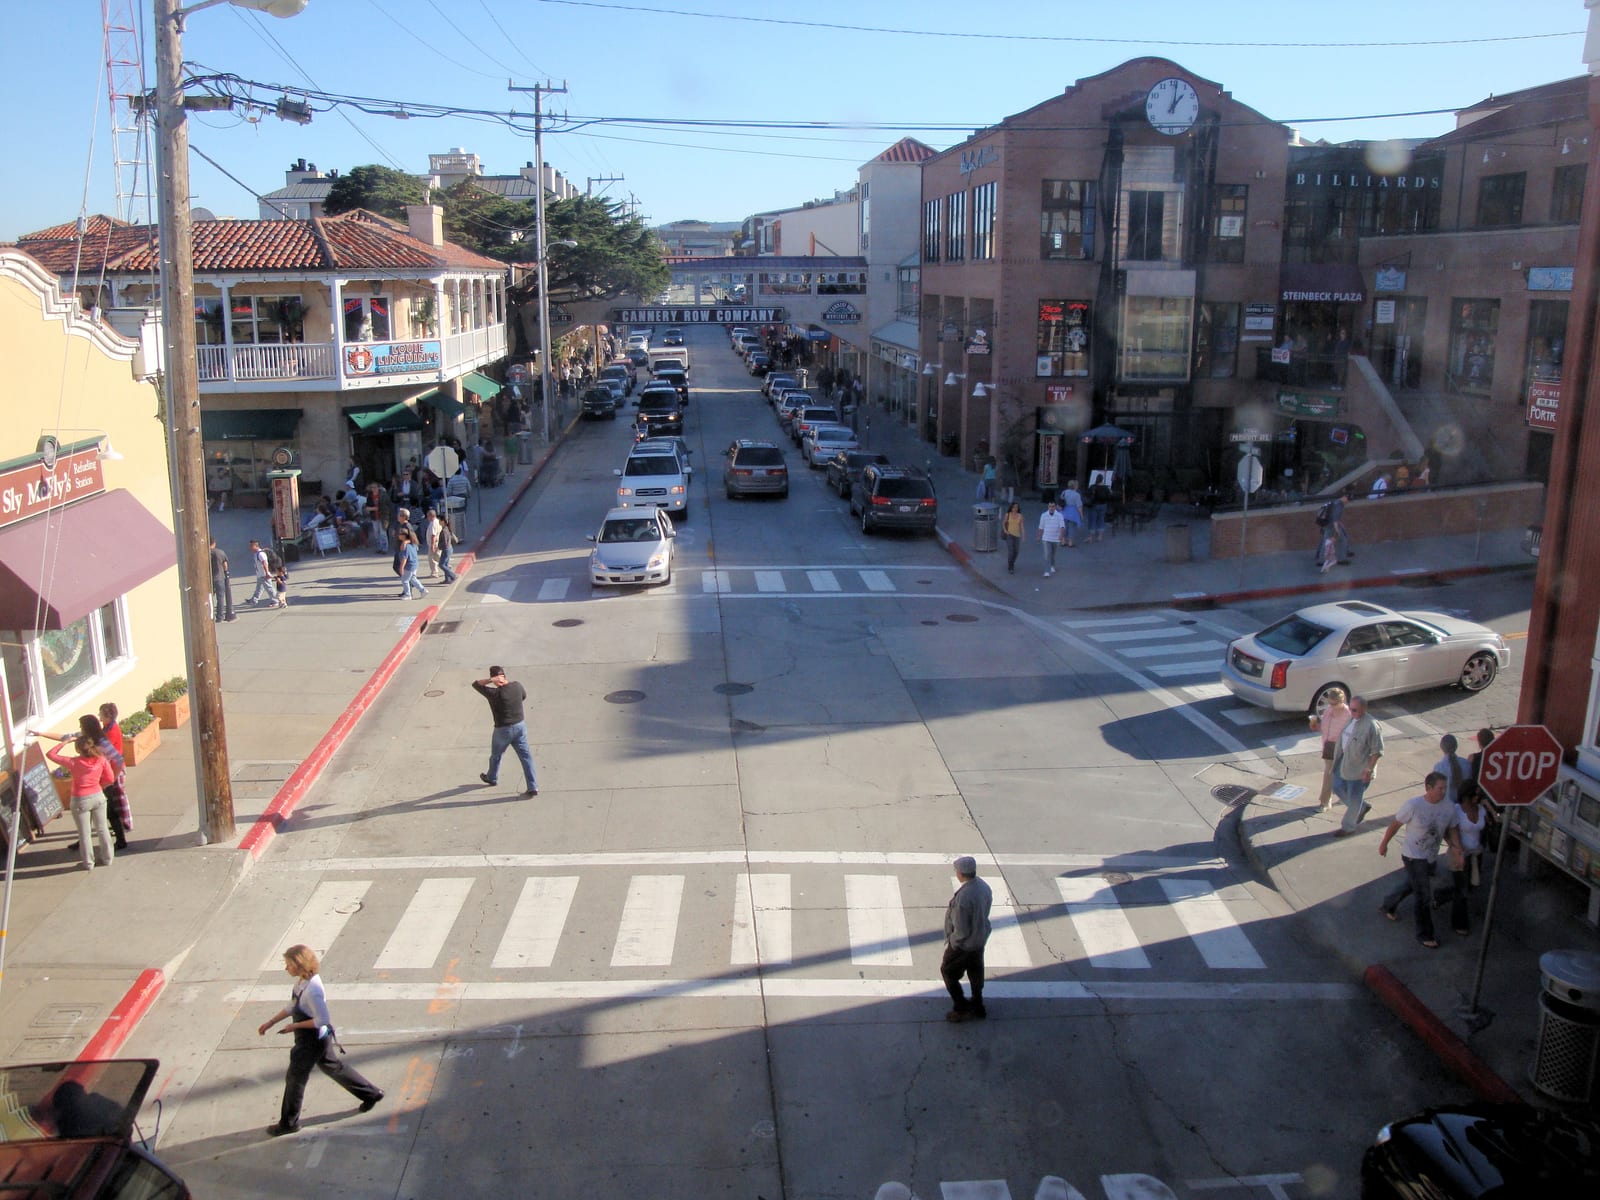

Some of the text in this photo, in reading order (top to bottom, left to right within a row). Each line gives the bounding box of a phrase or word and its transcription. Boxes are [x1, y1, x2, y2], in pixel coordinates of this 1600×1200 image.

[1296, 173, 1439, 188] BILLIARDS
[1282, 291, 1362, 301] STEINBECK PLAZA
[622, 309, 775, 322] CANNERY ROW COMPANY
[391, 344, 424, 355] LOUIE
[377, 352, 439, 366] LINGUINI'S
[1052, 391, 1067, 401] TV
[1530, 405, 1557, 422] PORTR
[2, 472, 72, 514] Sly McFly's
[1485, 751, 1556, 781] STOP
